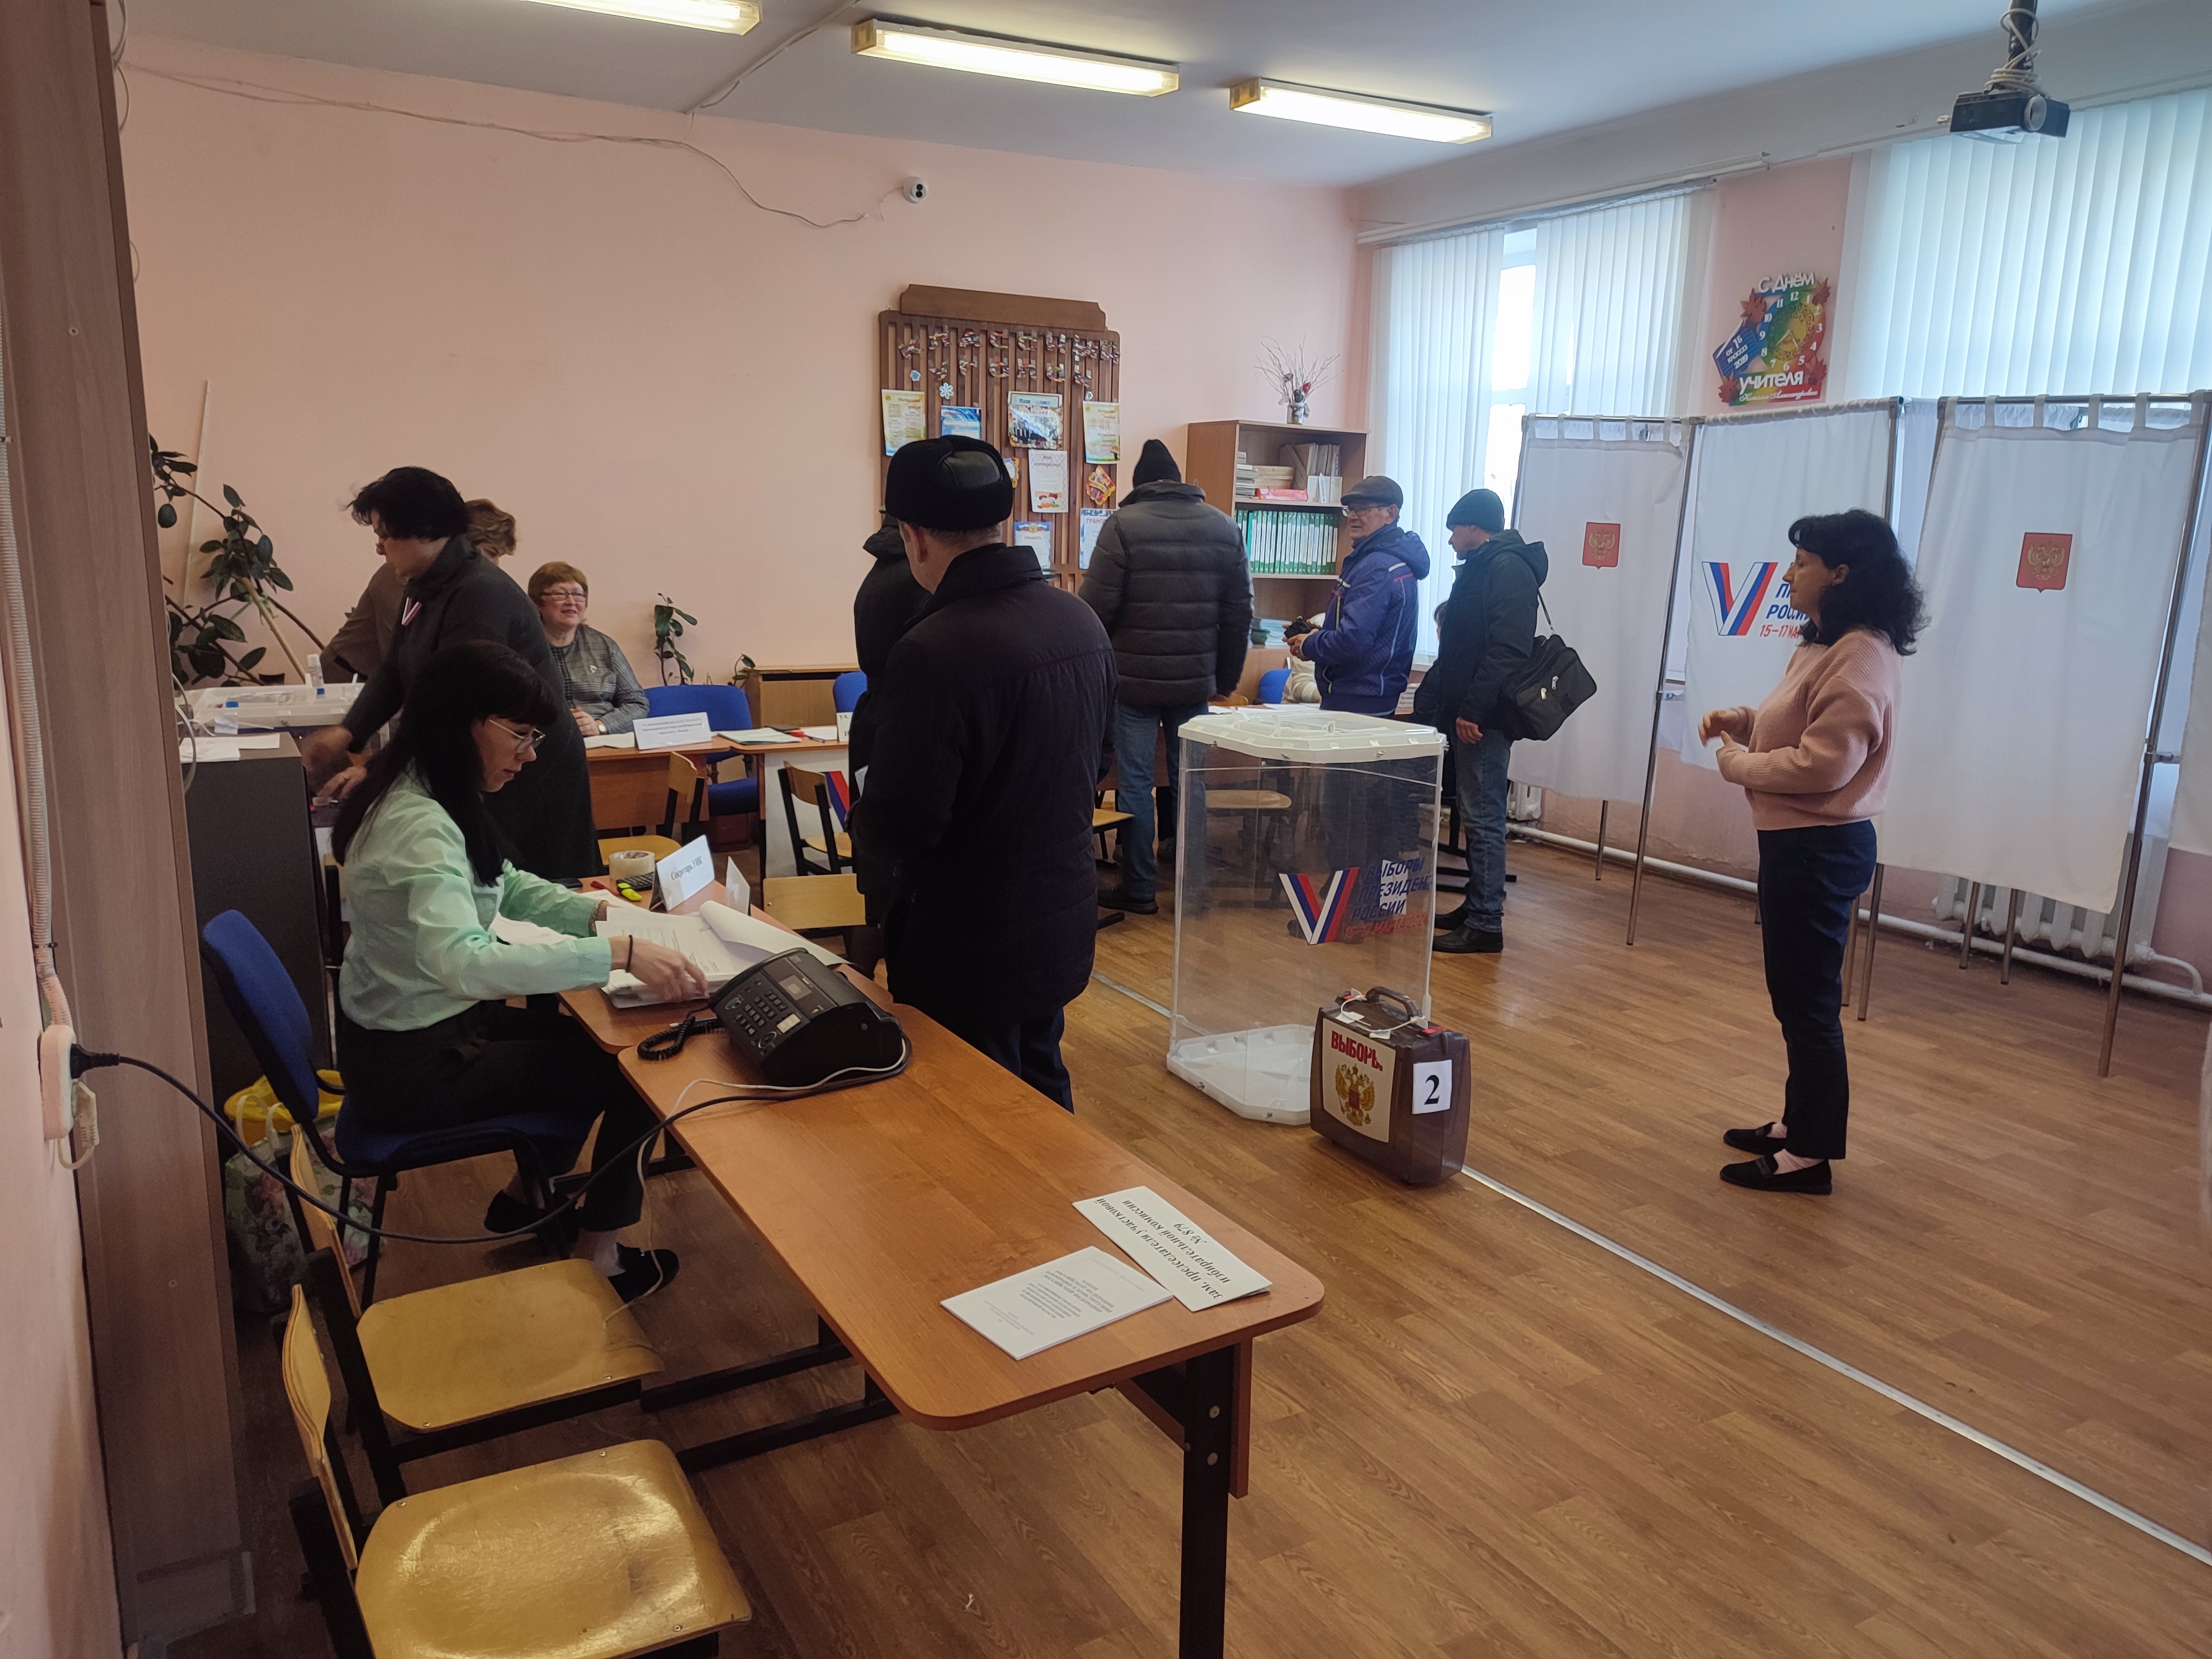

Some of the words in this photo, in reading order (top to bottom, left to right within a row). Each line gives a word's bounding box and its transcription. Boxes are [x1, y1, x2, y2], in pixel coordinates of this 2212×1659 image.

[1790, 291, 1799, 301] 12
[1806, 295, 1811, 304] 1
[1776, 299, 1783, 308] 11
[1814, 306, 1820, 315] 2
[1764, 313, 1772, 323] 10
[1815, 323, 1823, 333] 3
[1759, 331, 1765, 340] 9
[1809, 341, 1817, 351] 4
[1761, 348, 1767, 357] 8
[1770, 359, 1776, 368] 7
[1798, 355, 1805, 365] 5
[1783, 362, 1790, 371] 6
[1364, 858, 1425, 880] ВЫБОРЫ
[1351, 899, 1406, 922] РОССИИ
[1423, 1074, 1440, 1105] 2
[1093, 1198, 1147, 1234] участковой
[1121, 1200, 1164, 1230] комиссии
[1173, 1223, 1194, 1235] 879
[1140, 1234, 1201, 1281] председателя
[1158, 1230, 1230, 1283] избирательной
[1201, 1281, 1223, 1299] зам.
